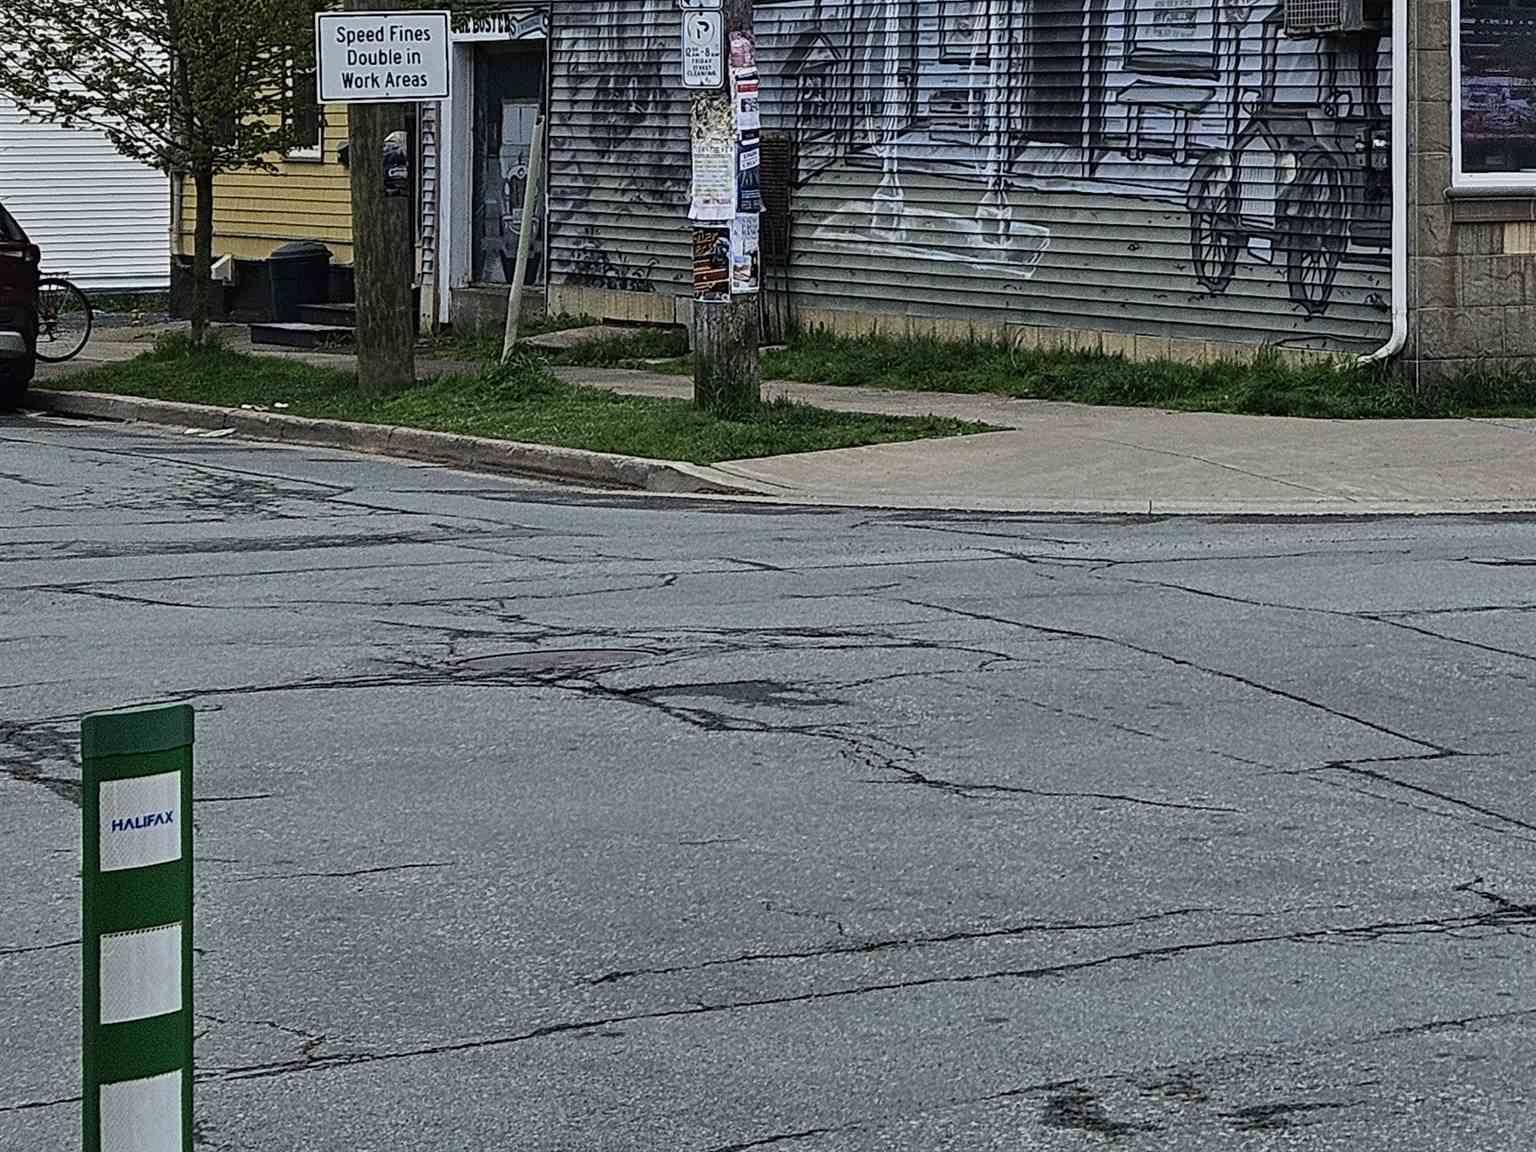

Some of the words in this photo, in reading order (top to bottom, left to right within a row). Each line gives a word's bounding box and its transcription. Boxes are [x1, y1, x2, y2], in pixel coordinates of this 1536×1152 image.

[336, 26, 384, 46] Speed
[390, 25, 431, 42] Fines
[347, 49, 402, 65] Double
[407, 48, 421, 65] in
[341, 72, 380, 88] Work
[385, 71, 427, 87] Areas
[111, 810, 174, 833] HALIFAX
